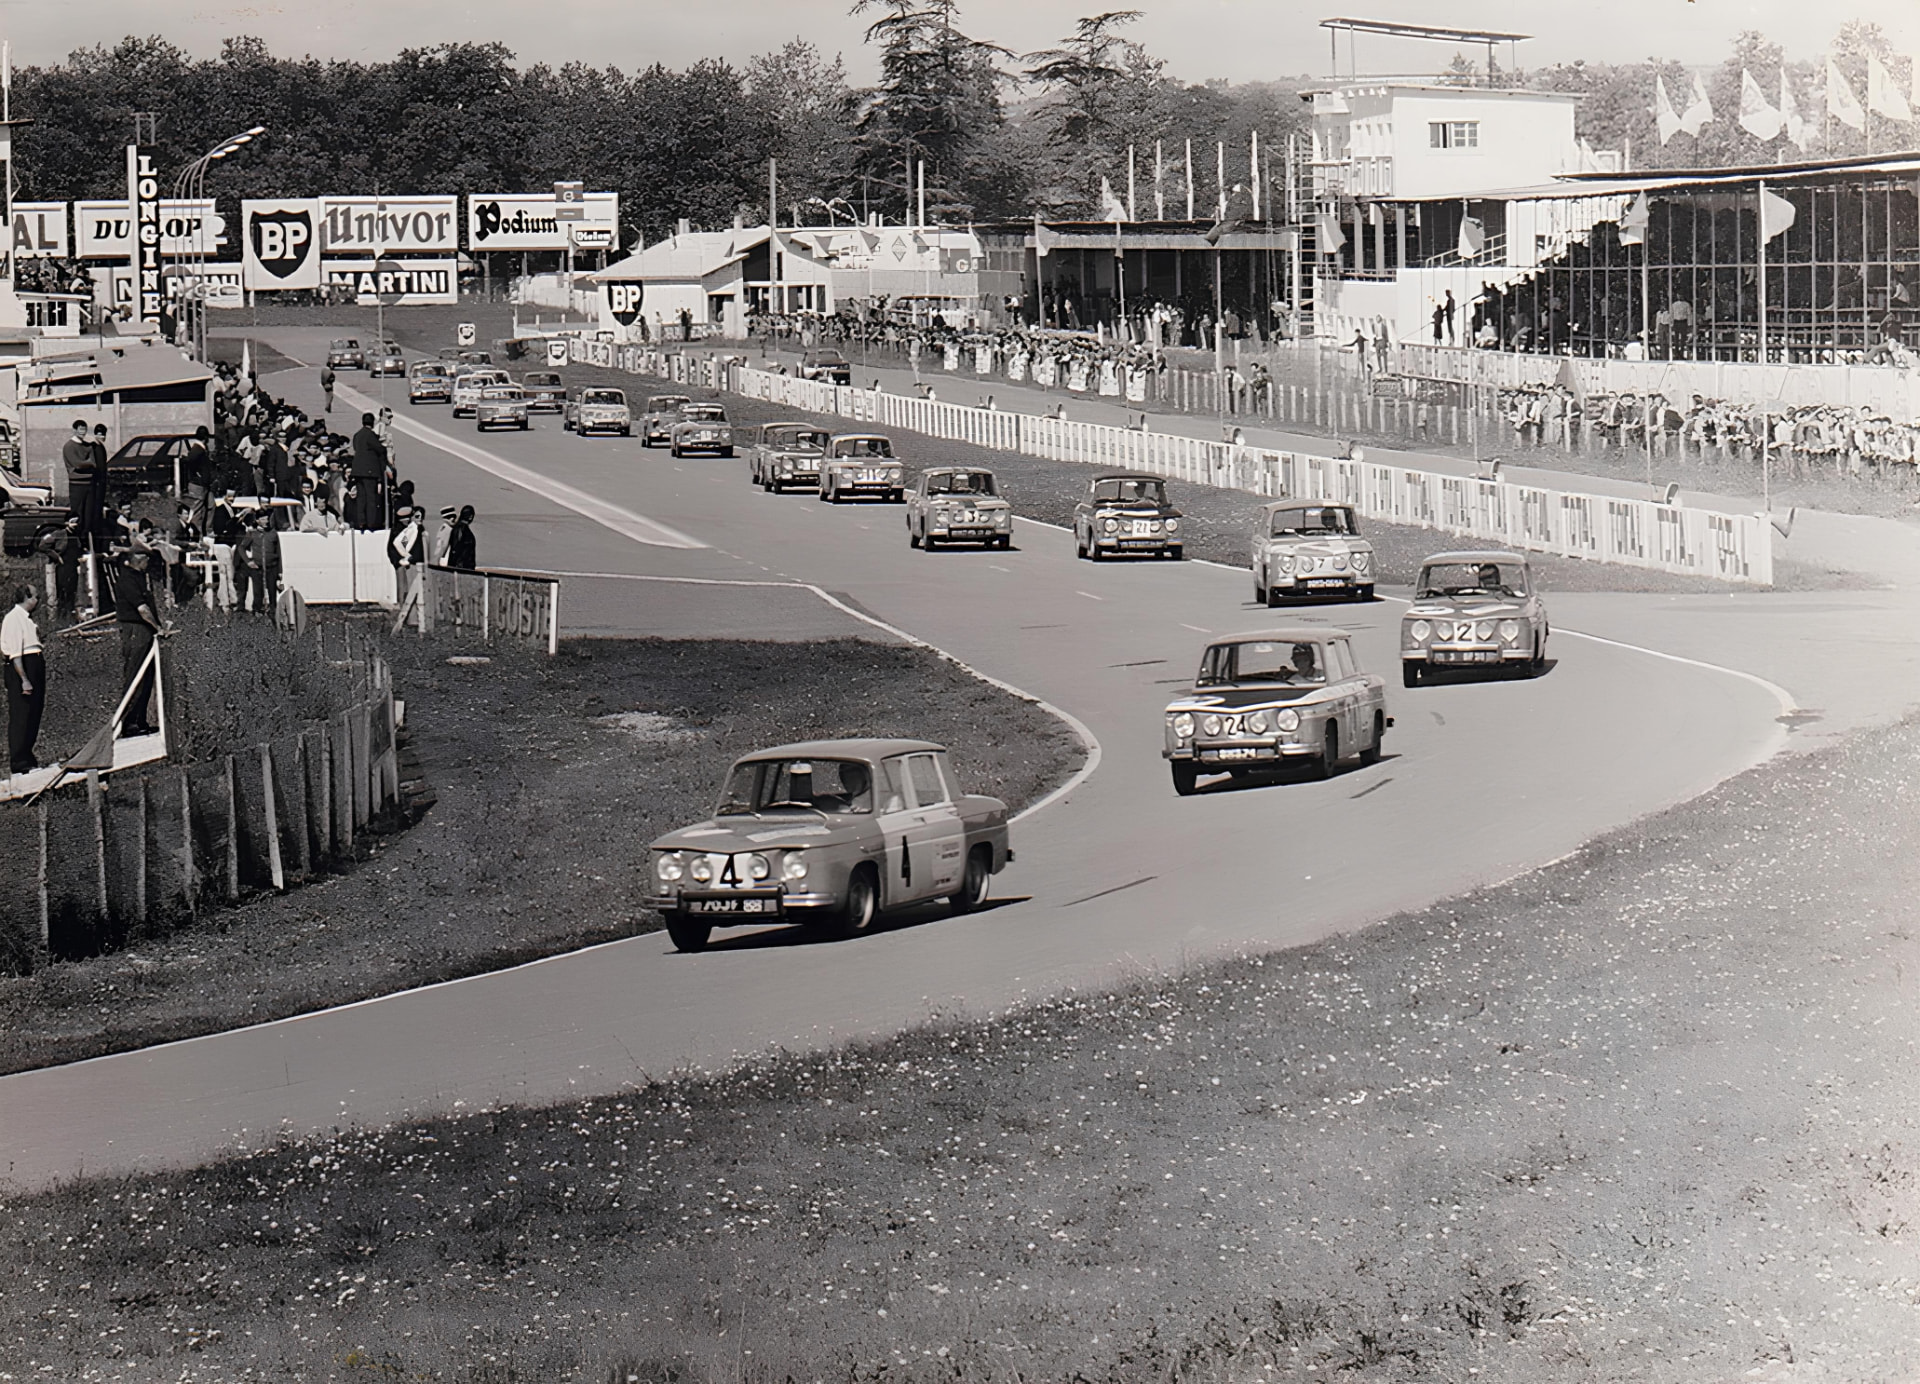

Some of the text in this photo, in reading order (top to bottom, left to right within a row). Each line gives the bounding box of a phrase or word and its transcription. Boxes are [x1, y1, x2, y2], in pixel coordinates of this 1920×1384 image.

[93, 218, 202, 239] DUOP
[326, 206, 450, 244] Univor
[475, 201, 558, 241] Podium
[260, 222, 308, 260] BP
[331, 271, 446, 293] MARTINI
[611, 285, 641, 313] BP
[1317, 558, 1325, 568] 7
[1225, 715, 1247, 735] 24
[719, 853, 743, 889] 4
